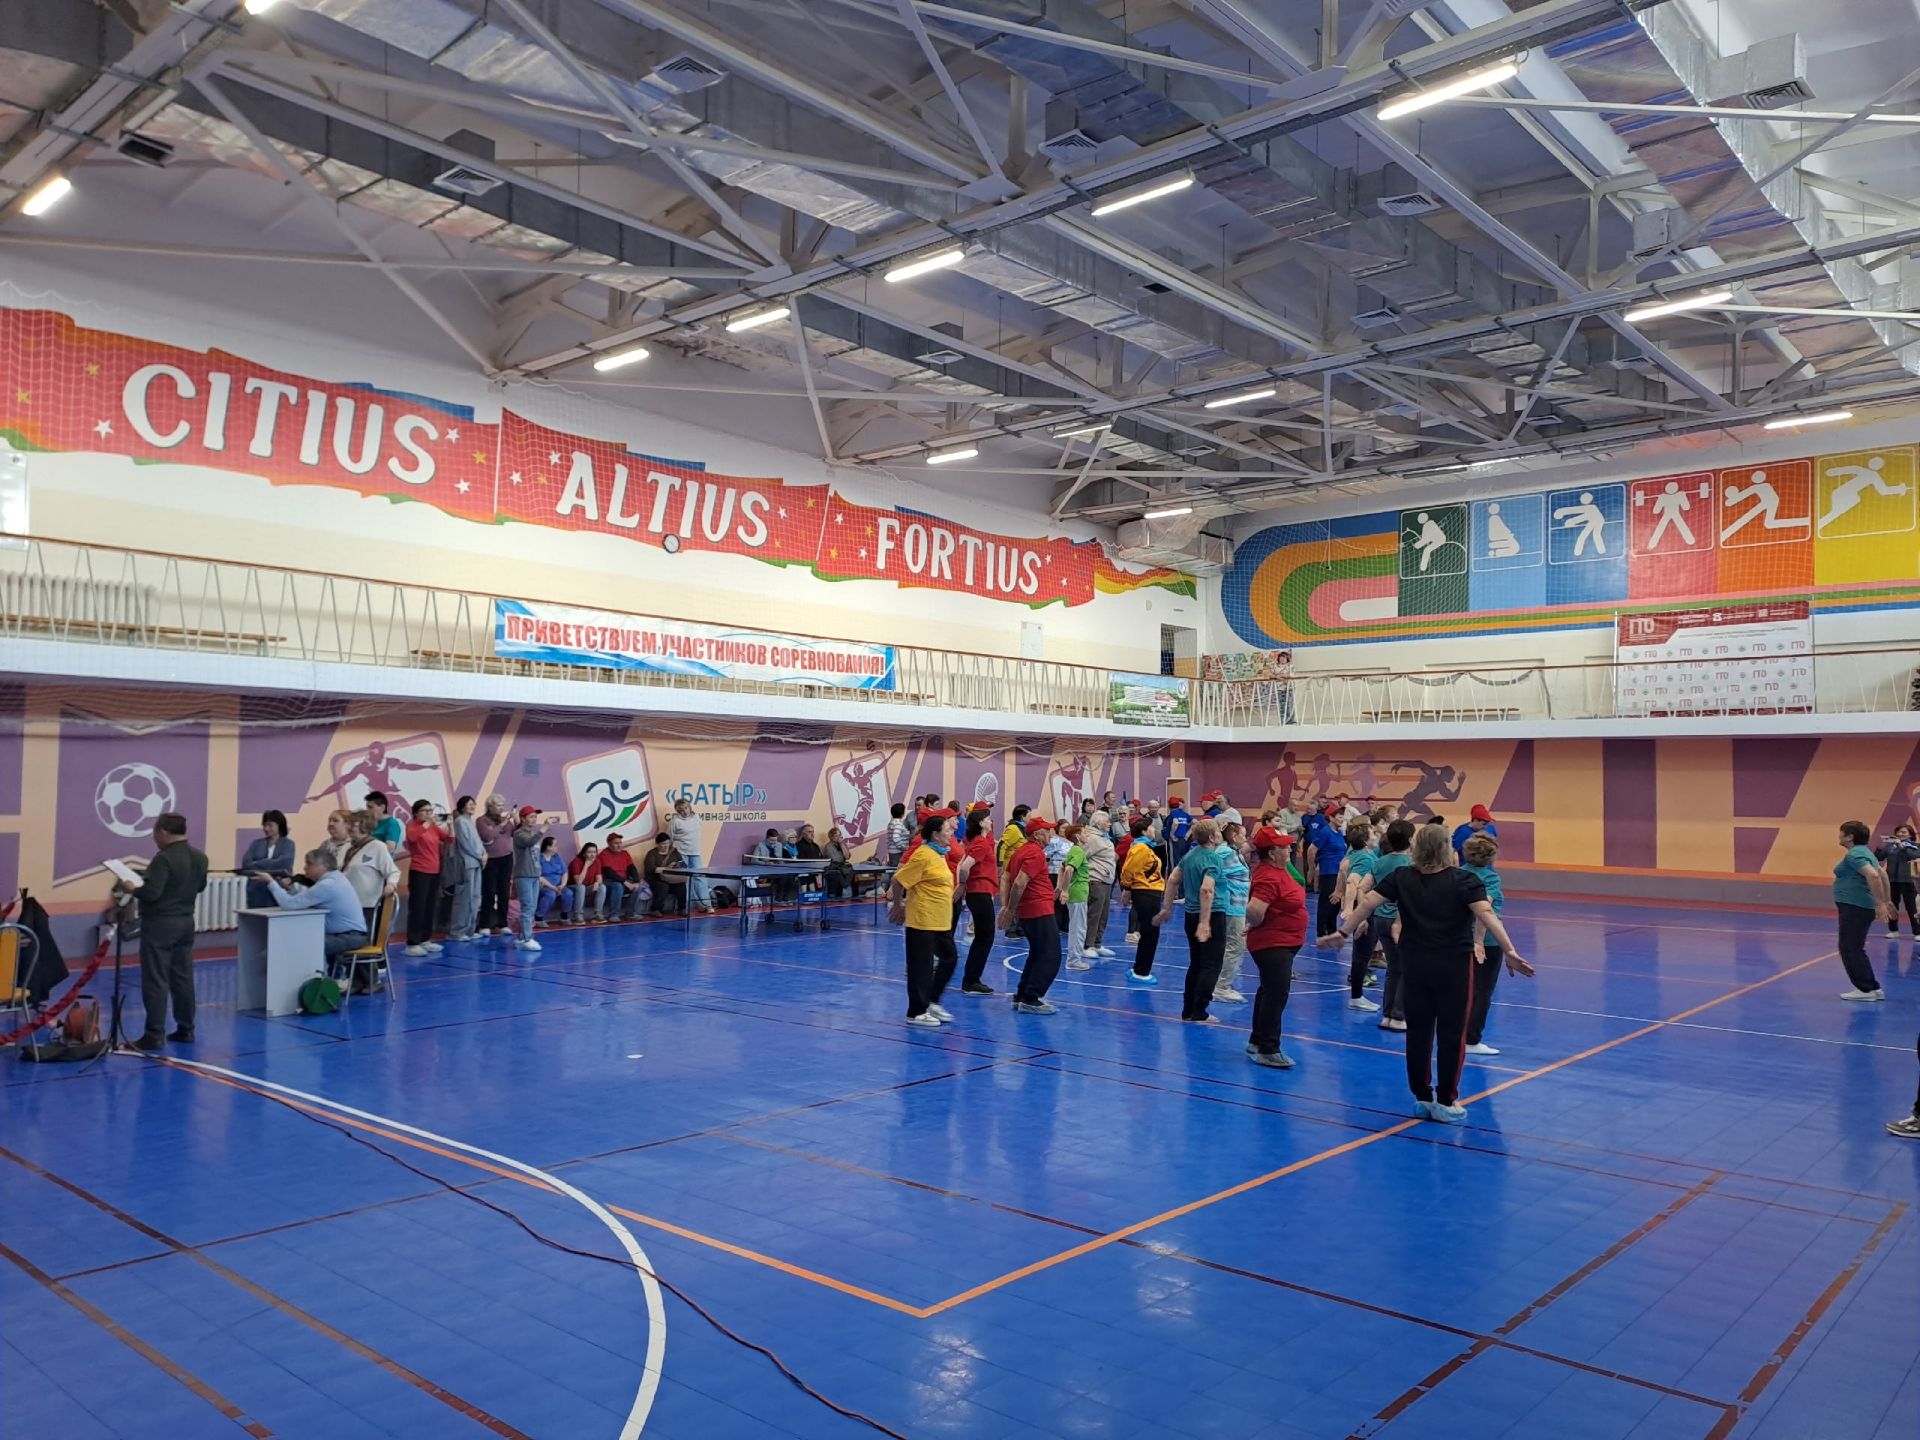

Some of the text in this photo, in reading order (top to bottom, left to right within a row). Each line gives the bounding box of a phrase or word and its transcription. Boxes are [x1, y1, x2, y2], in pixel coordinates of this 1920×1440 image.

[122, 363, 437, 485] CITIUS
[555, 450, 772, 547] ALTIUS
[875, 517, 1043, 596] FORTIUS
[506, 615, 885, 676] ПРИВЕТСТВУЕМ УЧАСТНИКОВ СОРЕВНОВАНИЯ!
[1629, 617, 1655, 635] ГТО
[1752, 643, 1767, 651] ГТО
[1791, 640, 1805, 649] ГТО
[733, 811, 767, 821] школа
